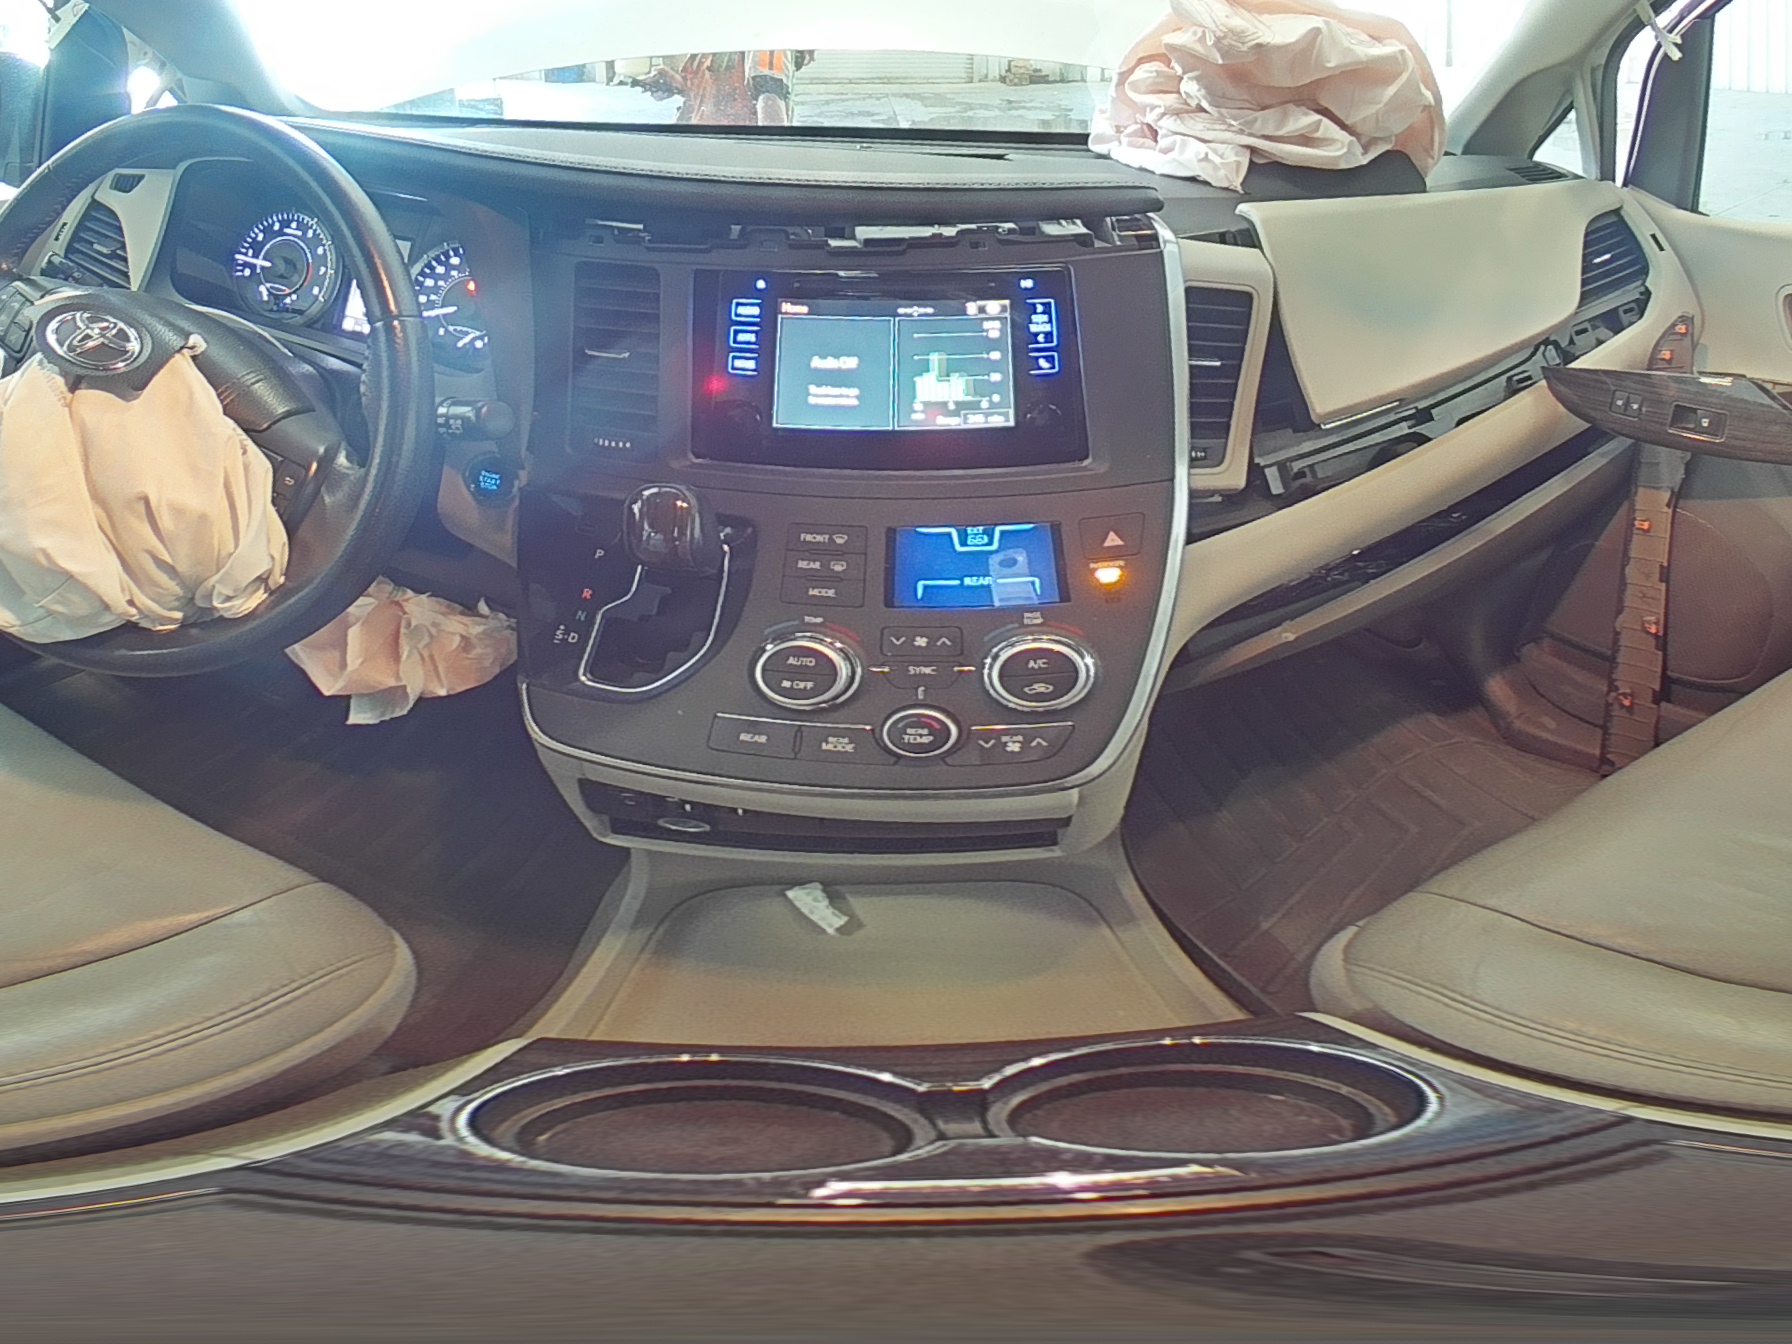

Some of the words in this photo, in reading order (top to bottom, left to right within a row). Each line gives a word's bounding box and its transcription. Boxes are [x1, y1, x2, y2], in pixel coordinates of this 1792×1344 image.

[781, 301, 809, 314] Home
[800, 533, 829, 543] FRONT
[594, 549, 605, 559] P
[797, 560, 821, 570] REAR
[581, 588, 593, 599] R
[808, 587, 836, 598] MODE
[575, 610, 587, 621] N
[786, 656, 816, 666] AUTO
[1027, 658, 1049, 669] A/C
[908, 666, 938, 675] SYNC
[793, 681, 816, 690] OFF
[739, 733, 768, 743] REAR
[902, 734, 935, 744] TEMP
[821, 742, 856, 753] MODE
